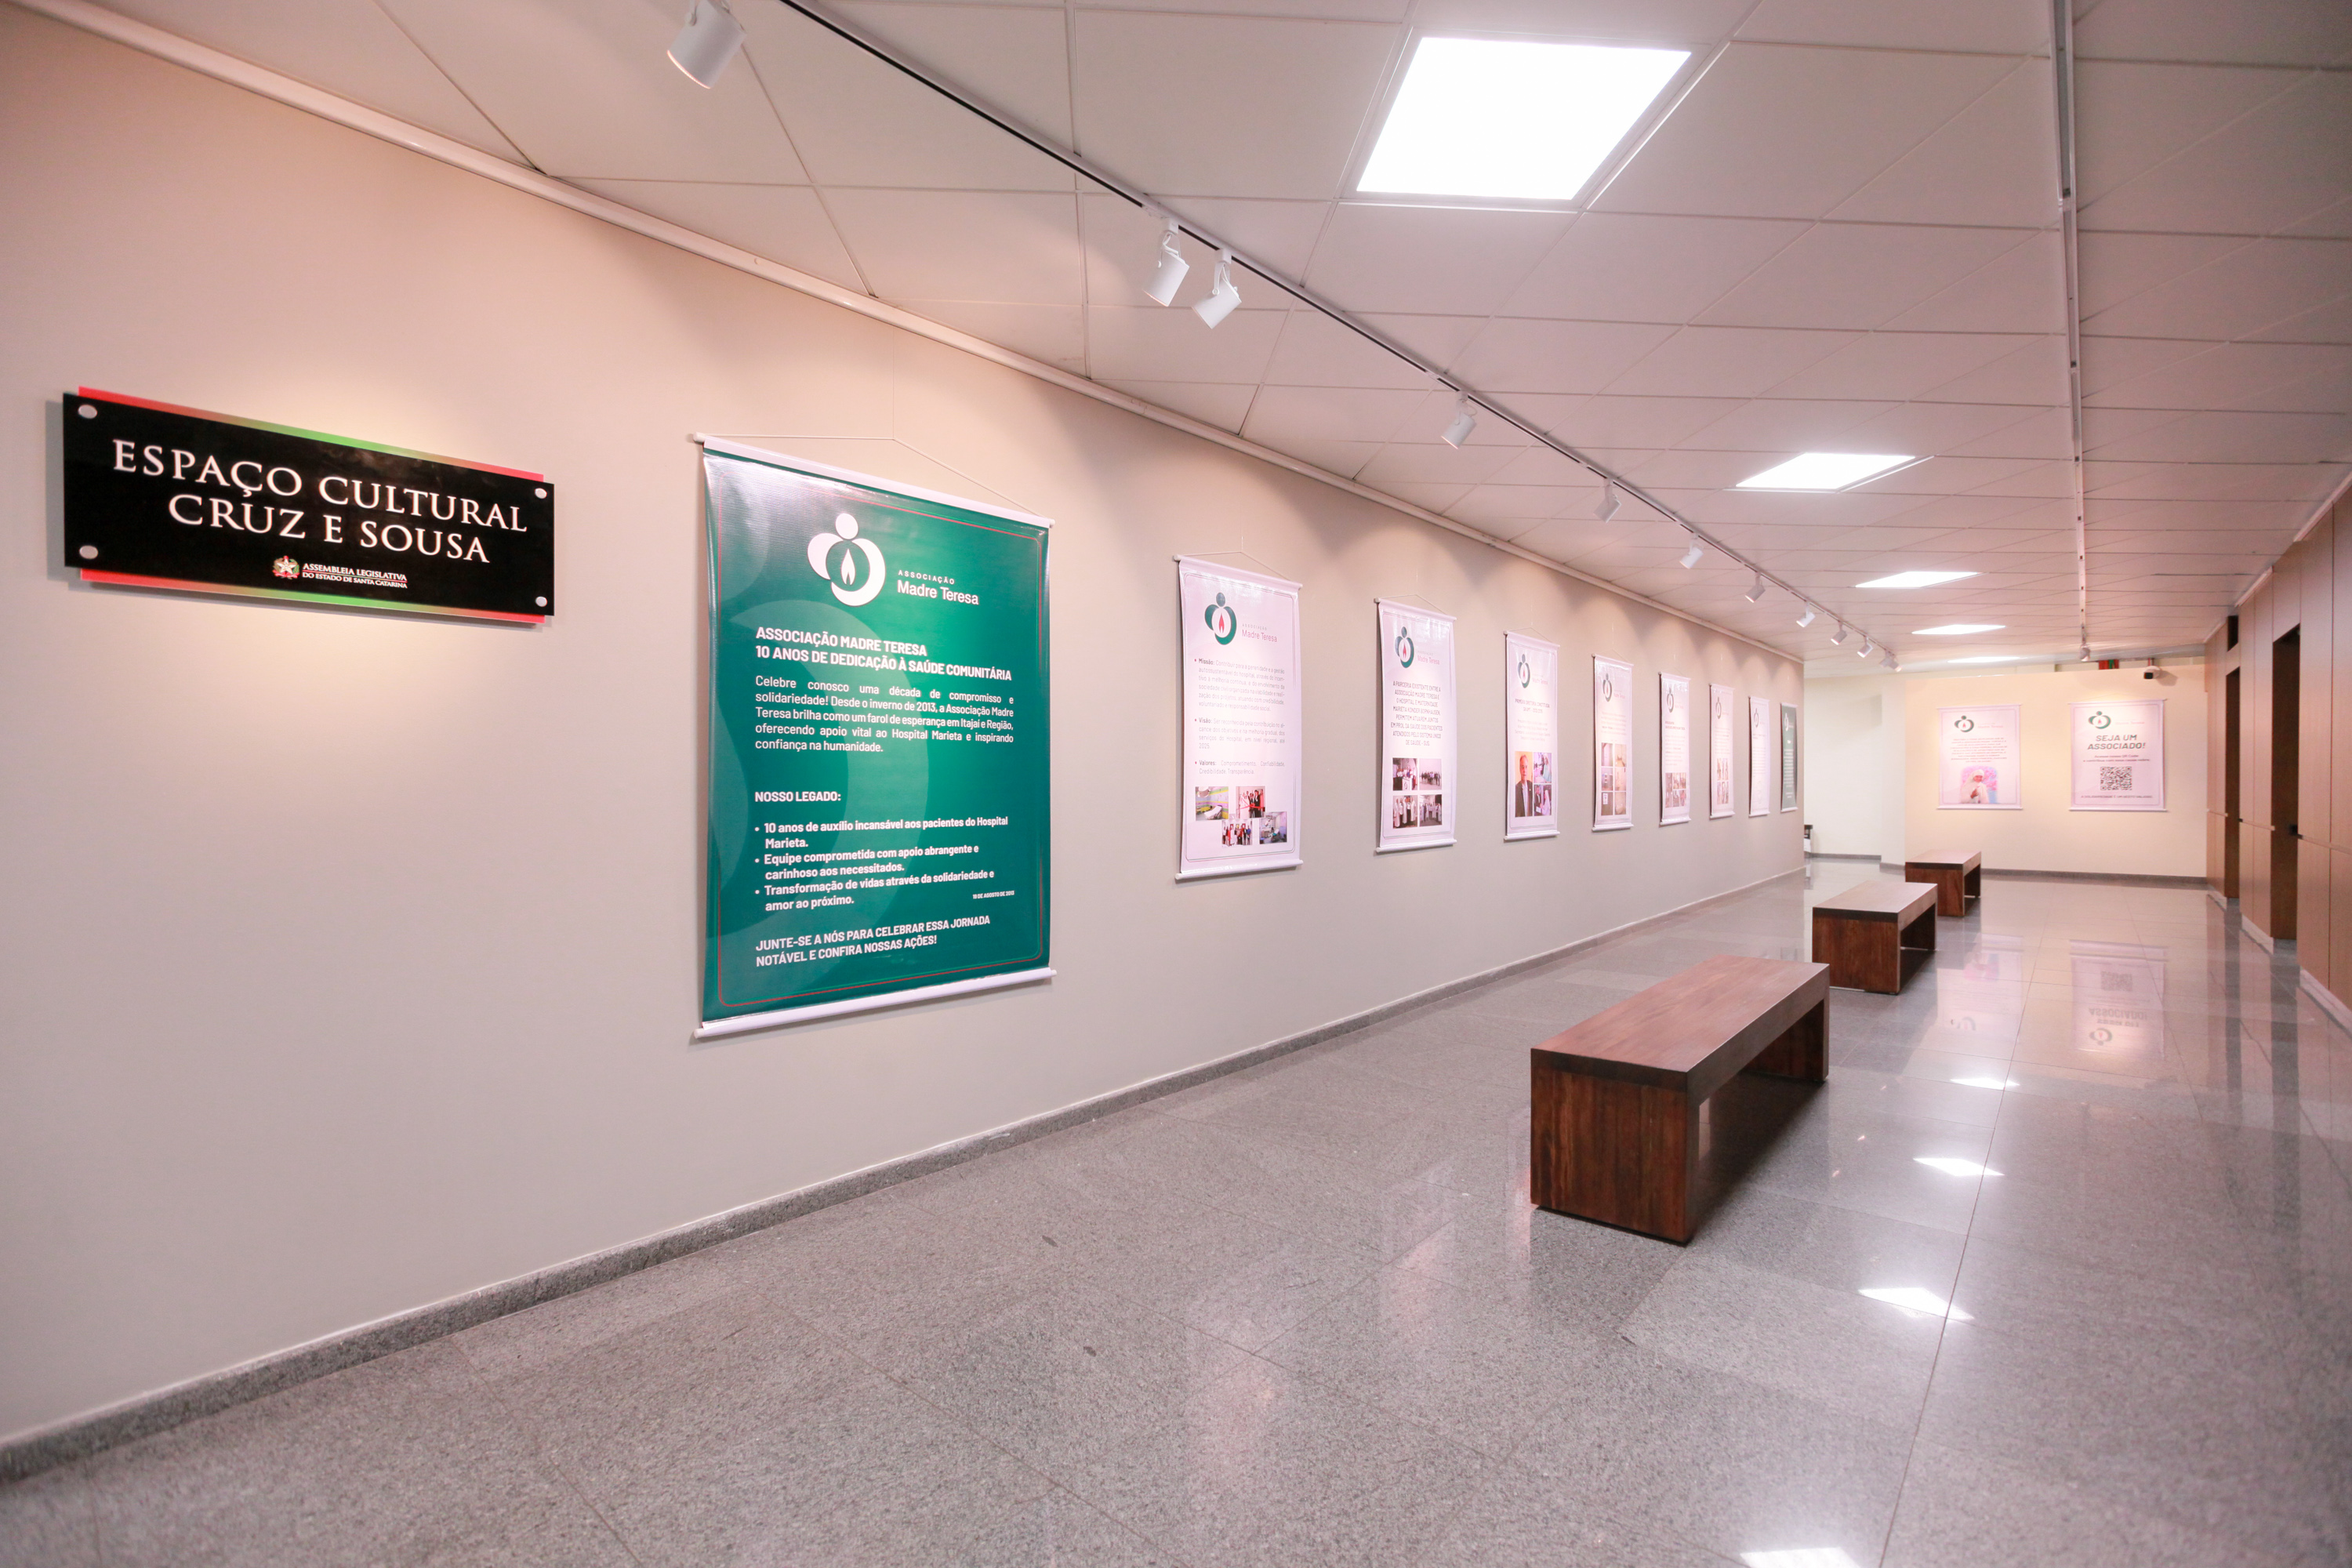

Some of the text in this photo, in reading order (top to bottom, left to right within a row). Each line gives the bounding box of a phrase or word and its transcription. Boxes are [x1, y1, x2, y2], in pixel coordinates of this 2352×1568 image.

[113, 439, 527, 532] ESPAÇO CULTURAL
[169, 495, 490, 563] CRUZ E SOUSA
[303, 564, 407, 580] ASSEMBLEIA LEGISLATIVA
[898, 570, 955, 584] ASSOCIAÇÃO
[376, 580, 408, 589] CATARINA
[897, 580, 979, 605] Madre Teresa
[756, 627, 927, 656] ASSOCIAÇÃO MADRE TERESA
[1242, 630, 1277, 643] Madre Teresa
[756, 645, 1012, 681] 10 ANOS DE DEDICAÇÃO À SAÚDE COMUNITÁRIA
[756, 675, 797, 689] Celebre
[807, 682, 850, 693] conosco
[858, 685, 880, 695] uma
[888, 685, 922, 698] década
[928, 688, 941, 699] de
[948, 689, 1002, 704] compromisso
[756, 691, 828, 706] solidariedade!
[830, 696, 860, 708] Desde
[862, 700, 868, 709] o
[869, 699, 902, 710] inverno
[904, 700, 915, 711] de
[916, 701, 938, 713] 2013,
[946, 703, 989, 717] Associação
[991, 706, 1014, 717] Madre
[756, 706, 791, 720] Teresa
[793, 709, 821, 721] brilha
[822, 713, 850, 722] como
[851, 714, 866, 723] um
[867, 713, 887, 724] farol
[889, 713, 900, 724] de
[902, 717, 946, 728] esperança
[960, 717, 979, 731] Itajaí
[986, 719, 1014, 731] Região,
[756, 723, 815, 735] oferecendo
[819, 725, 848, 739] apoio
[851, 726, 872, 738] vital
[875, 730, 887, 739] ao
[891, 728, 928, 742] Hospital
[931, 729, 963, 741] Marieta
[975, 731, 1014, 744] inspirando
[756, 738, 884, 752] confiança na humanidade.
[755, 791, 841, 802] NOSSO LEGADO:
[764, 816, 1008, 833] 10 anos de auxílio incansável aos pacientes do Hospital
[764, 837, 808, 849] Marieta.
[764, 851, 801, 866] Equipe
[803, 848, 875, 863] comprometida
[877, 850, 897, 858] com
[898, 847, 923, 859] apoio
[924, 844, 973, 857] abrangente
[764, 861, 905, 880] carinhoso aos necessitados.
[764, 879, 844, 896] Transformação
[844, 878, 858, 890] de
[859, 877, 884, 889] vidas
[886, 874, 919, 887] através
[920, 873, 931, 884] da
[933, 869, 989, 883] solidariedade
[764, 894, 854, 911] amor ao próximo.
[756, 915, 990, 951] JUNTE-SE A NÓS PARA CELEBRAR ESSA JORNADA
[756, 934, 937, 967] NOTÁVEL E CONFIRA NOSSAS AÇÕES!
